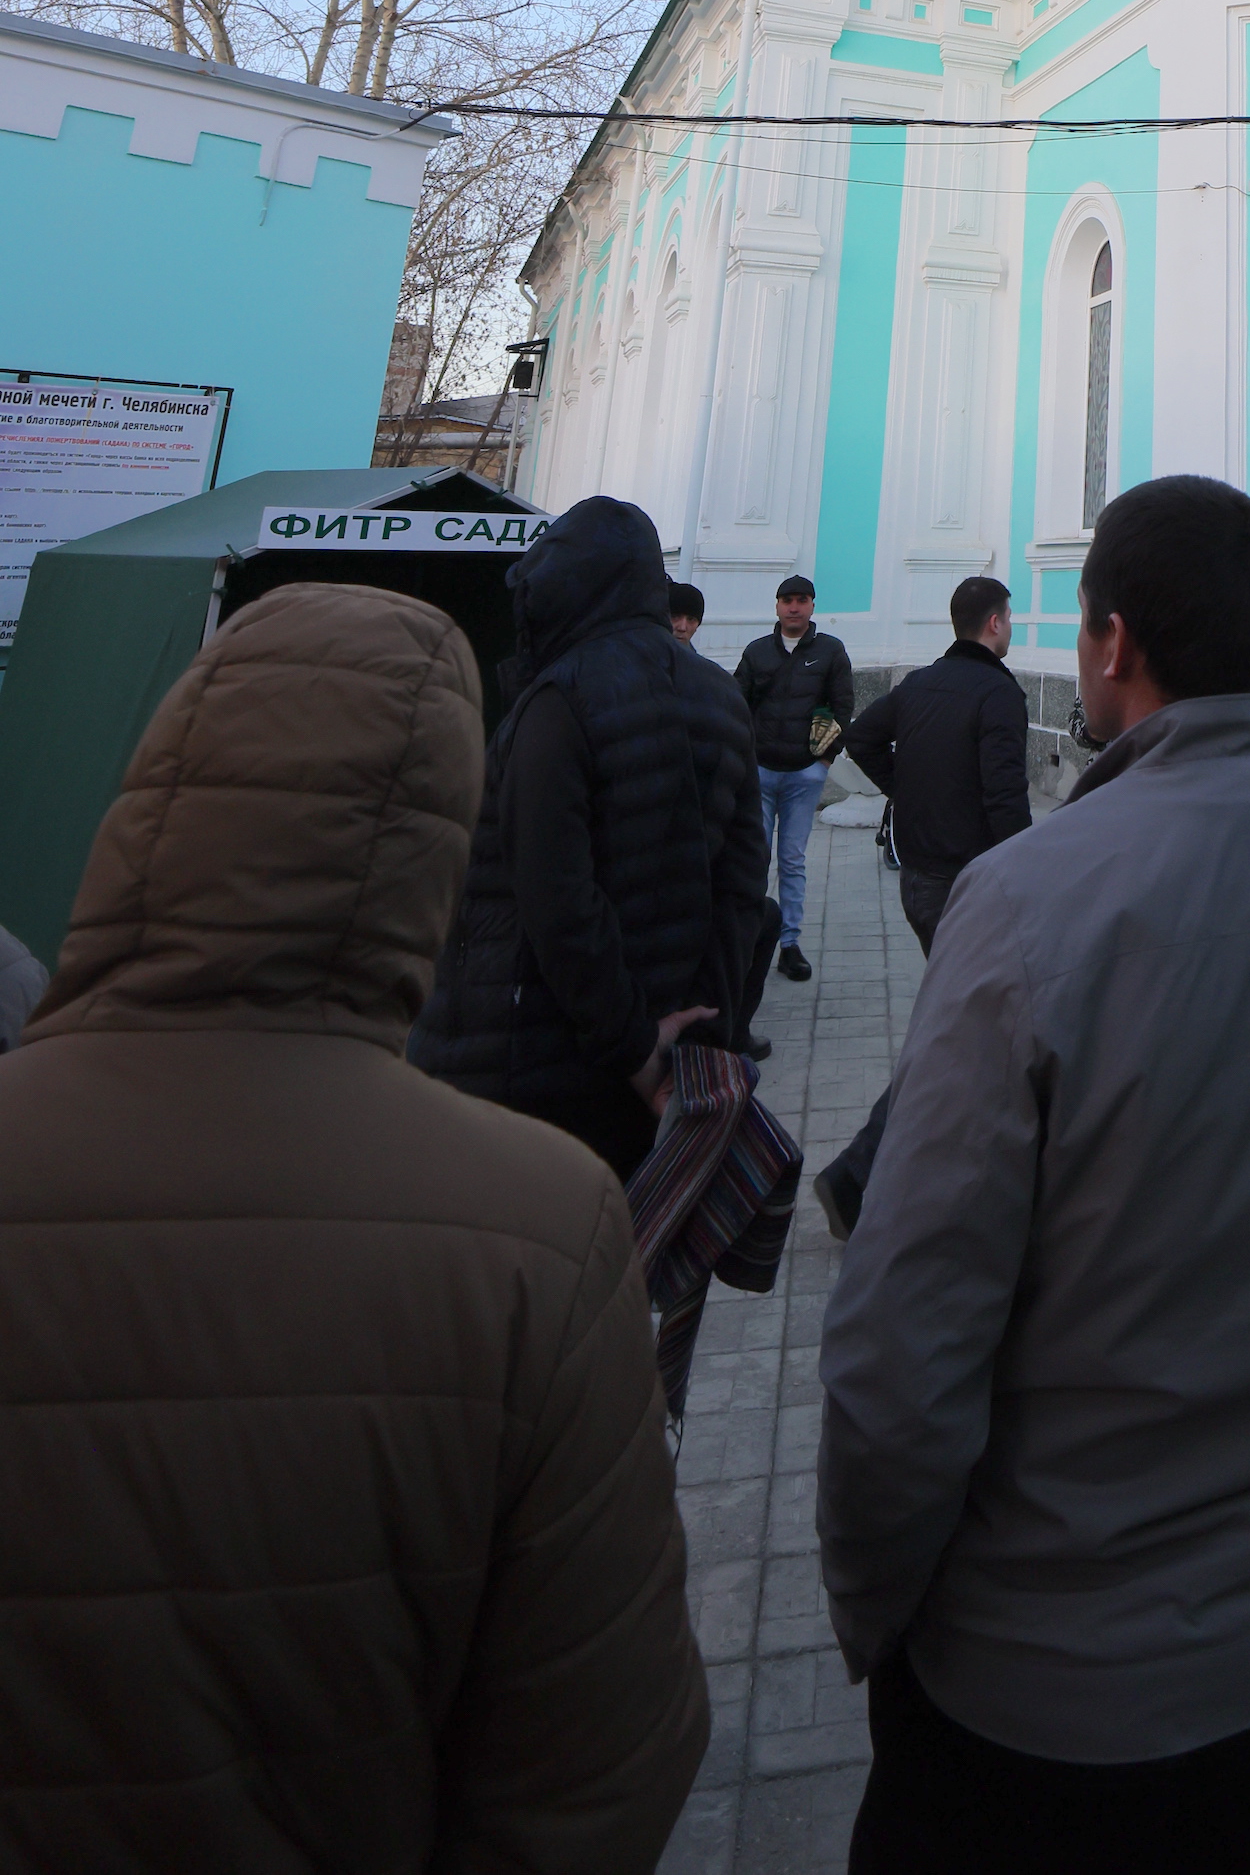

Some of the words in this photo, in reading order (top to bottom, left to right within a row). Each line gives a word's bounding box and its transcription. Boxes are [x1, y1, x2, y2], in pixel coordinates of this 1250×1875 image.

[39, 393, 97, 408] мечети
[103, 397, 114, 410] г.
[122, 396, 209, 416] Челябинска
[26, 414, 119, 429] благотворительной
[121, 421, 184, 433] деятельности
[46, 437, 99, 445] ПОЖЕРТВОВАНИЙ
[269, 514, 412, 540] ФИТР
